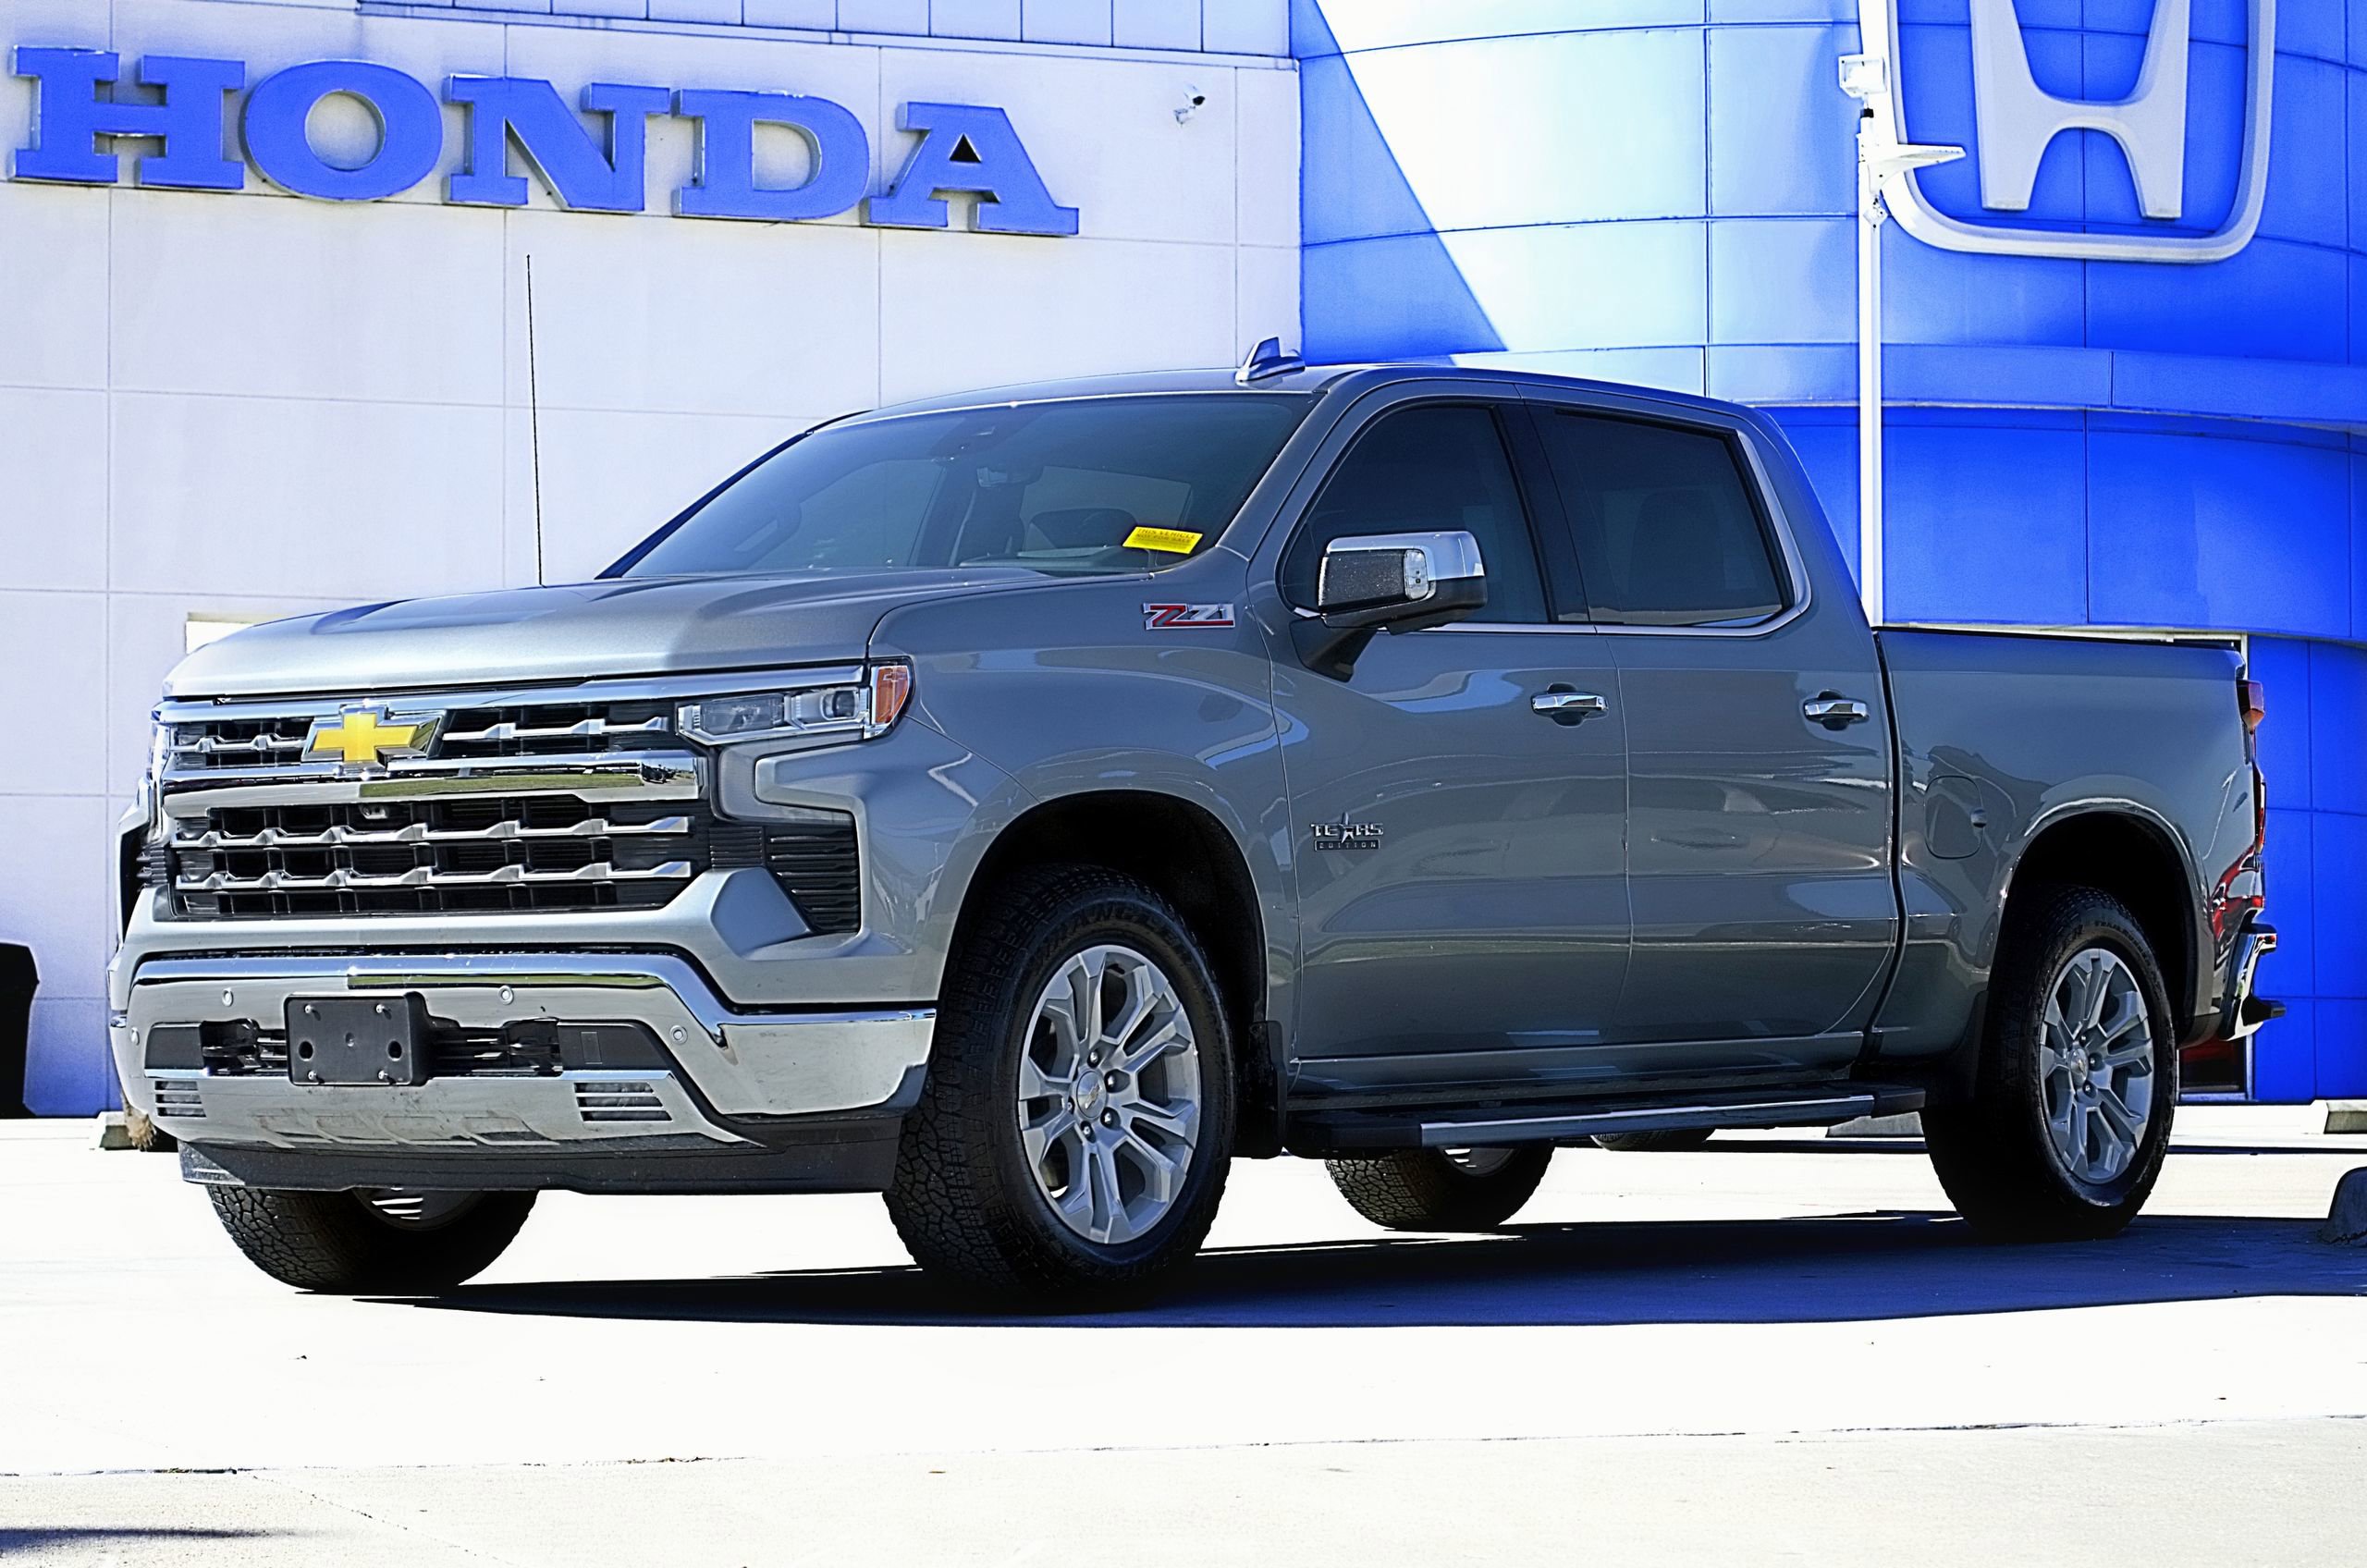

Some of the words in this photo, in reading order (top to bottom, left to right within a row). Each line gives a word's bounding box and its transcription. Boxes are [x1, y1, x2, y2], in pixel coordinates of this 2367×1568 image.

[12, 45, 1080, 237] HONDA
[1159, 531, 1196, 539] VEHICLE
[1143, 603, 1235, 631] Z71
[1318, 841, 1377, 850] EDITION
